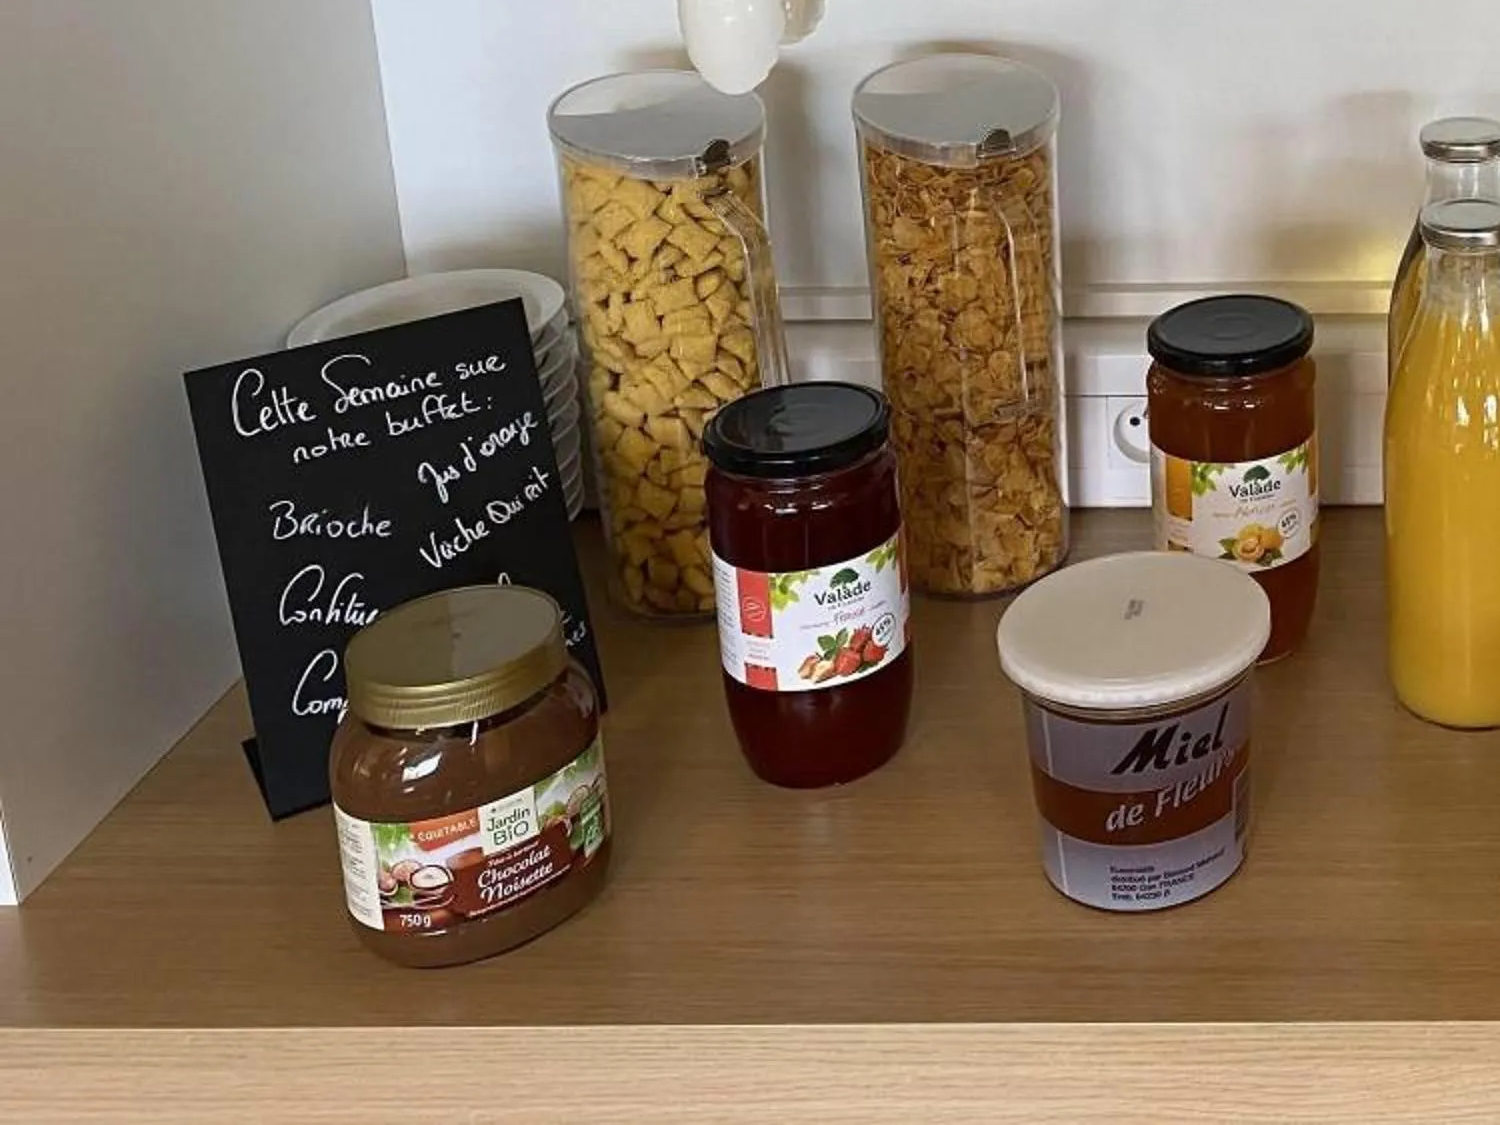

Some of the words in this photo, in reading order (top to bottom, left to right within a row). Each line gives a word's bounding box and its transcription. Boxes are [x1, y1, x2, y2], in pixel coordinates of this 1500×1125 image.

[231, 368, 317, 437] Cette
[321, 354, 442, 414] Semaine
[455, 355, 507, 380] sur
[293, 427, 371, 464] notre
[418, 462, 461, 504] Jus
[269, 500, 392, 540] Brioche
[419, 518, 490, 568] Vache
[486, 494, 525, 524] Qui
[524, 466, 550, 502] rit
[279, 564, 379, 625] Confitu
[1110, 700, 1229, 775] Miel
[486, 807, 531, 832] Jardin
[1106, 804, 1145, 831] de
[478, 844, 551, 888] Chocolat
[480, 861, 553, 904] Noisette
